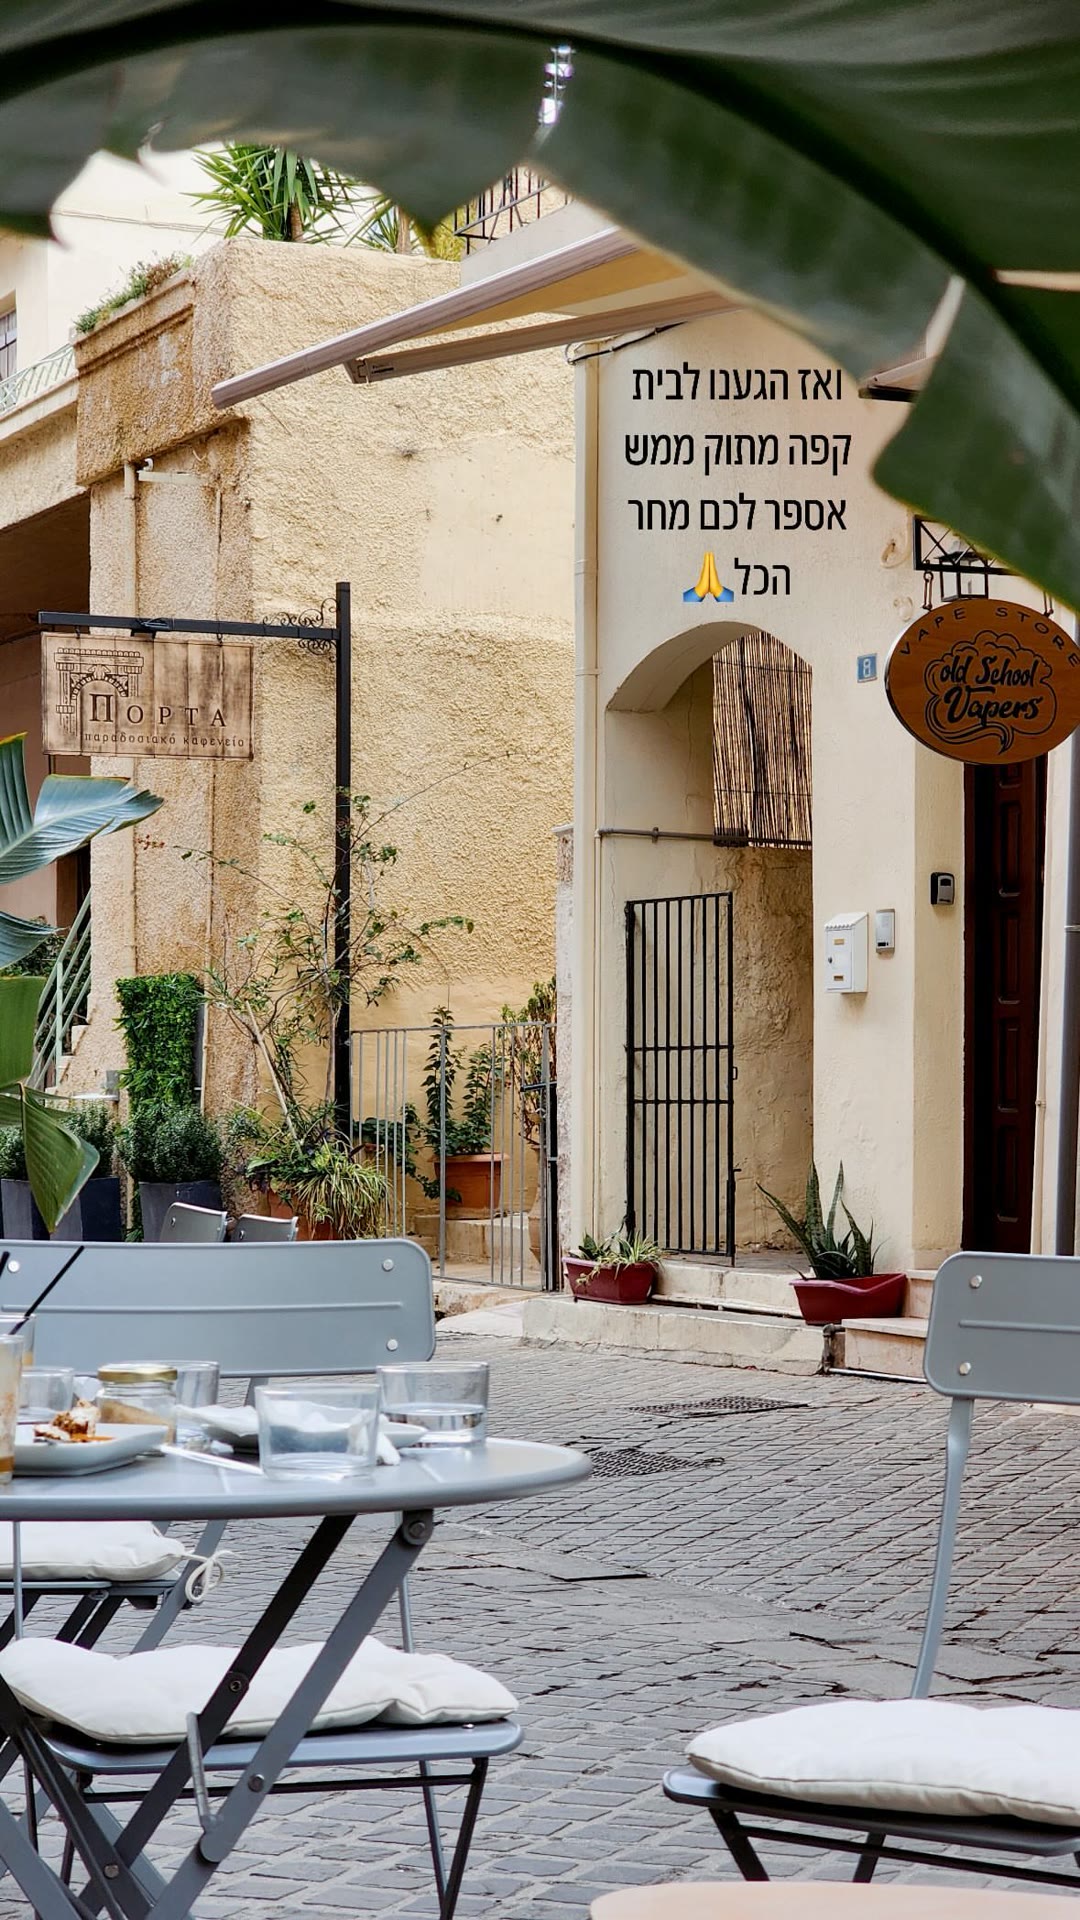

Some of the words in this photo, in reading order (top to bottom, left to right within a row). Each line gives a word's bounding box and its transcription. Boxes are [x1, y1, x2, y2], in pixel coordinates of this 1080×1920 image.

[900, 608, 967, 656] VAPE
[995, 607, 1080, 668] STORE
[863, 658, 871, 678] 8
[975, 656, 1040, 688] School
[89, 693, 227, 728] ΠΟΡΤΑ
[943, 684, 1044, 727] Vapers
[84, 731, 177, 745] παραδοσιακό
[183, 735, 245, 748] καφενείο
